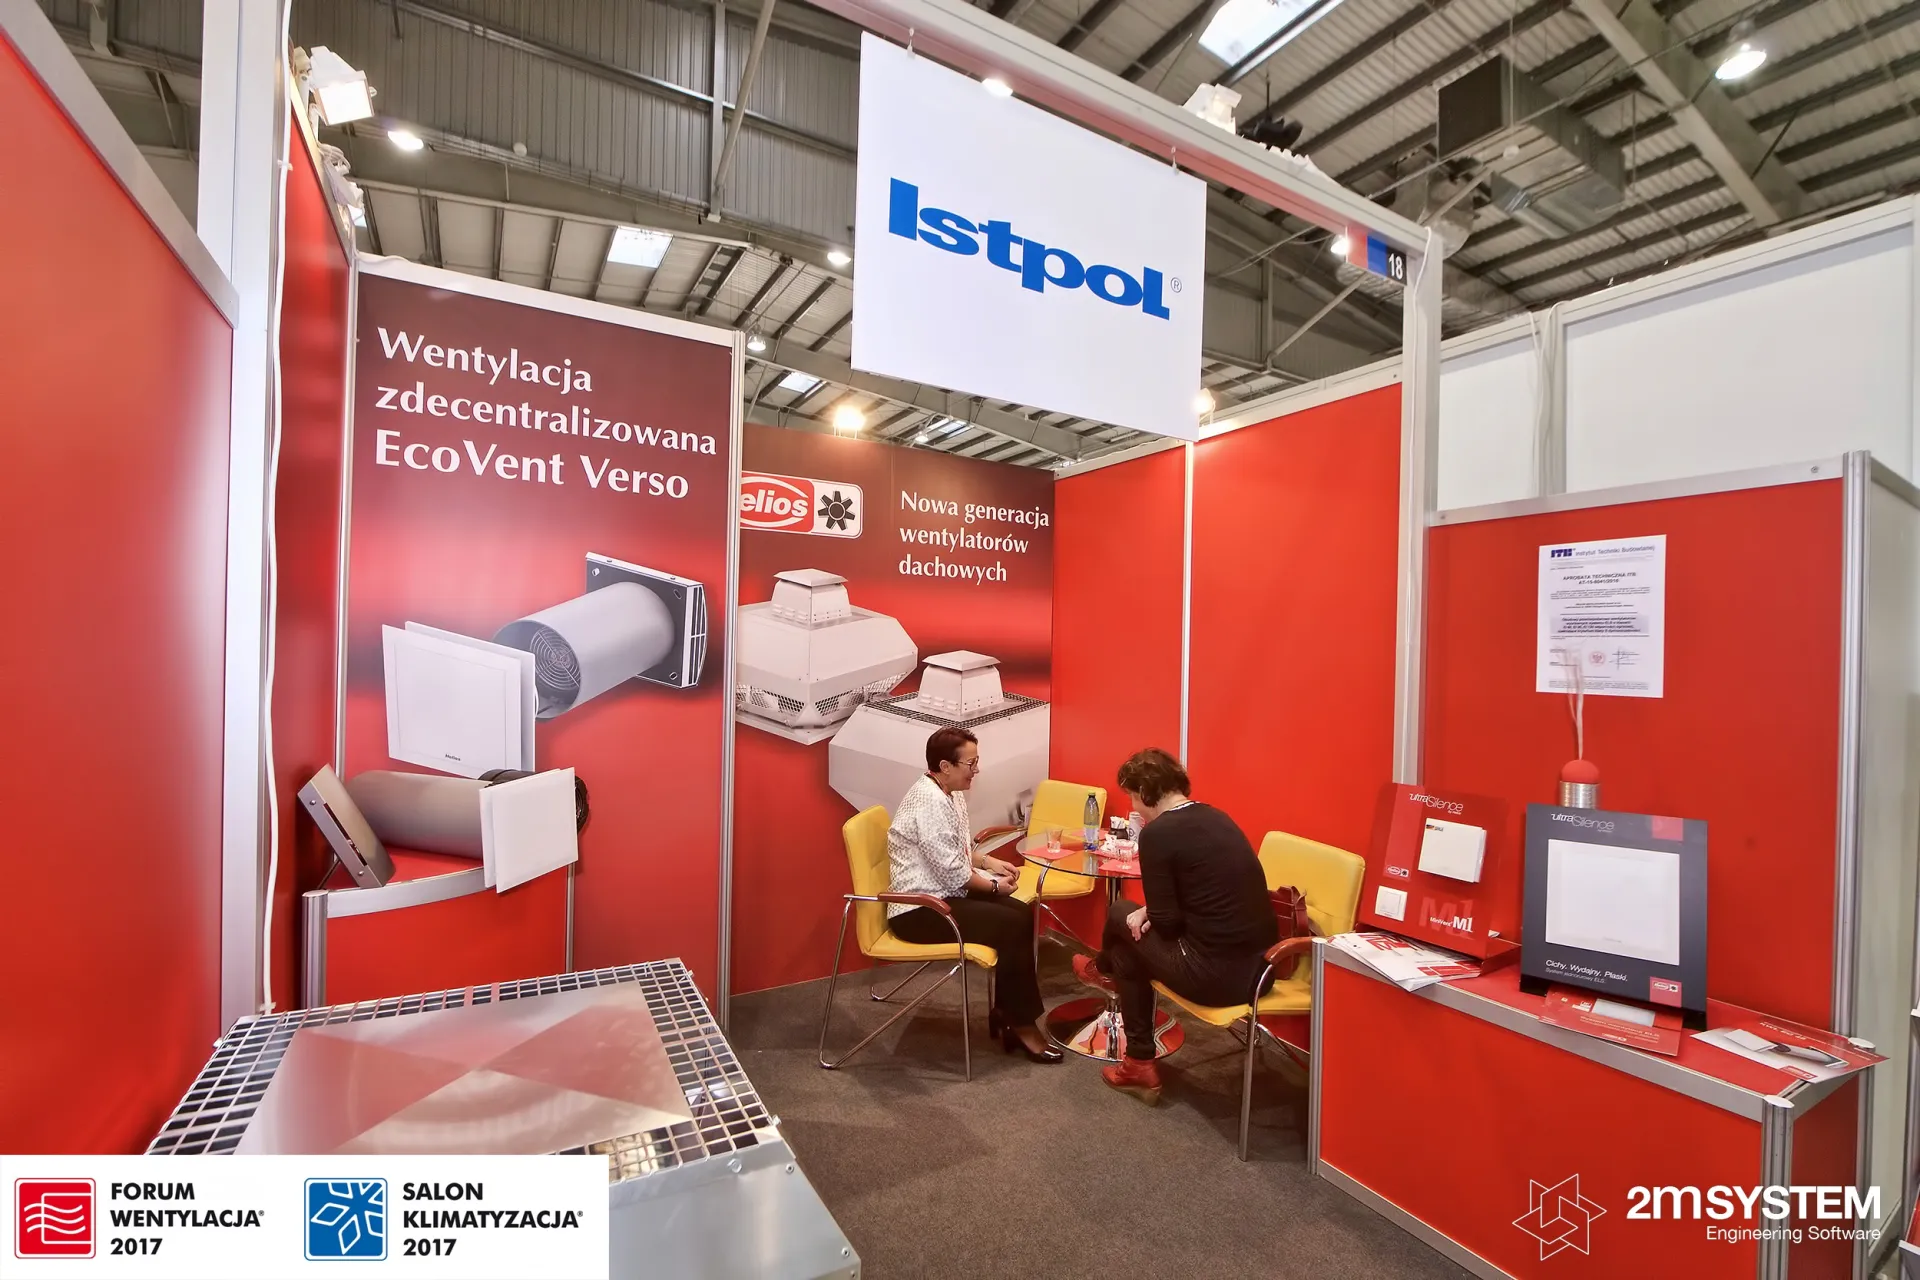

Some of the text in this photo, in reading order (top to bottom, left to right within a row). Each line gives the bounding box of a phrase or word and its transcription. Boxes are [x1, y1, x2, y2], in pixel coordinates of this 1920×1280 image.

[1388, 253, 1403, 279] 18
[377, 327, 592, 395] Wentylacja
[375, 381, 717, 456] zdecentralizowana
[375, 428, 690, 499] EcoVent Verso
[740, 488, 808, 518] elios
[901, 490, 1050, 530] Nowa generacja
[899, 527, 1029, 553] wentylatorów
[898, 554, 1007, 586] dachowych
[1452, 916, 1474, 933] M1
[1570, 963, 1602, 978] Wydajny.
